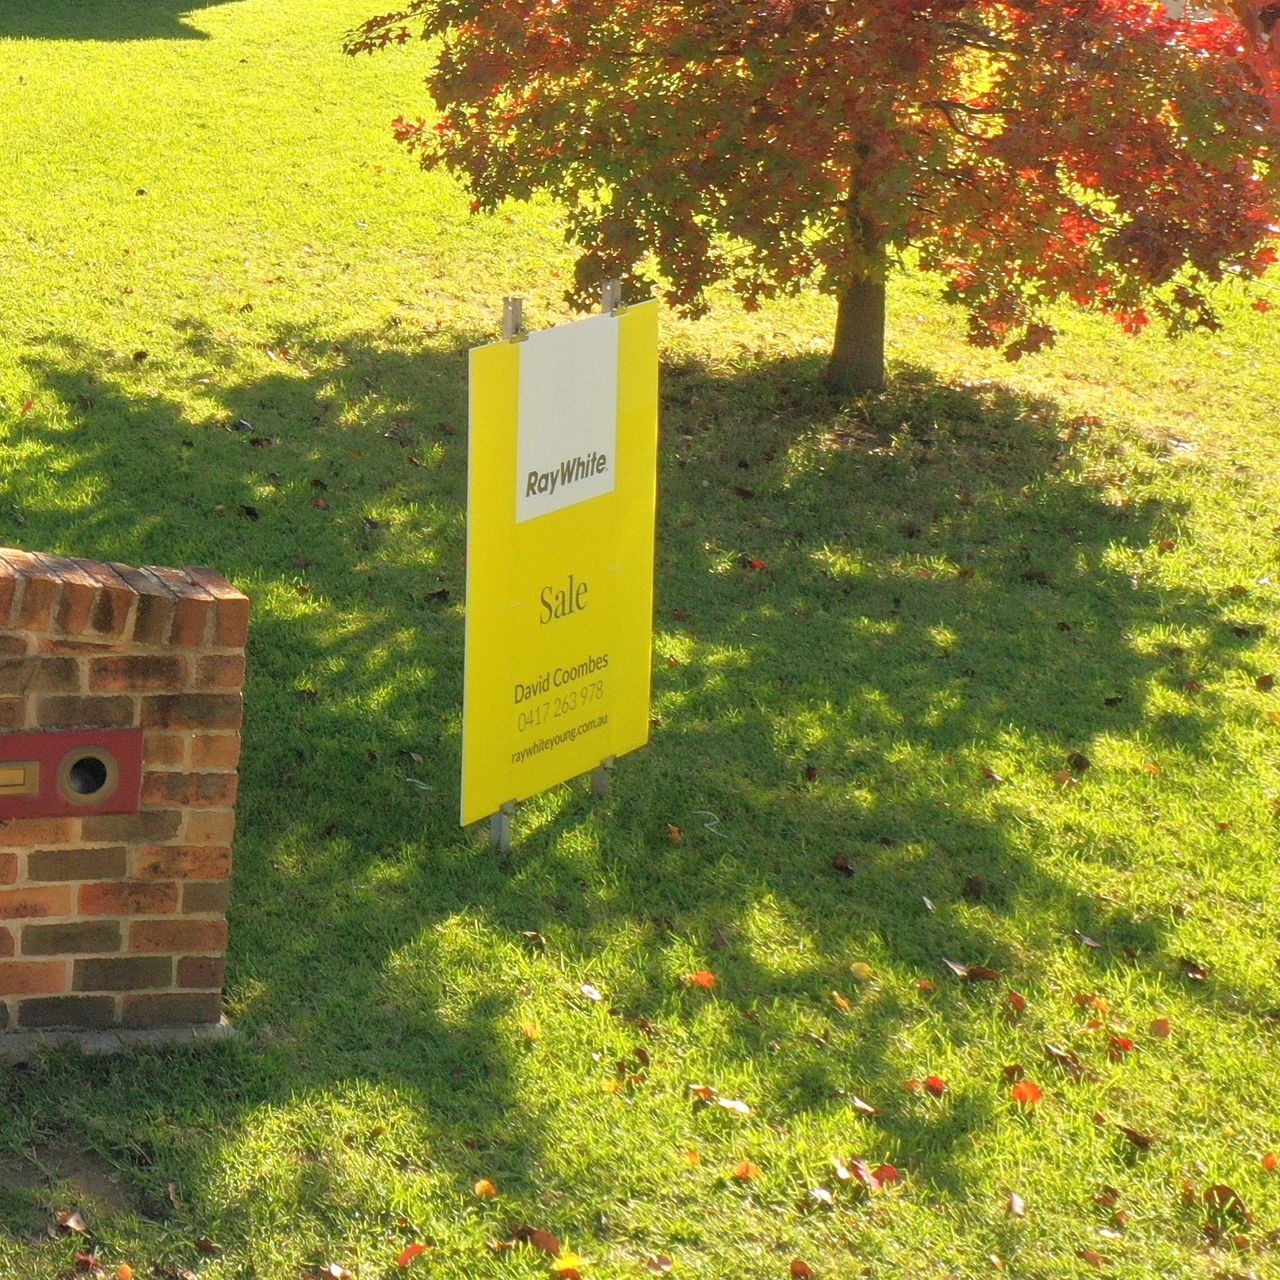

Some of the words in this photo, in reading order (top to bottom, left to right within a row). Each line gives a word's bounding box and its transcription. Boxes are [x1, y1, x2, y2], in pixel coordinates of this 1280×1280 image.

[540, 574, 588, 625] Sale
[514, 672, 550, 705] David
[553, 654, 609, 687] Coombes
[517, 702, 550, 733] 0417
[554, 691, 577, 718] 263
[580, 680, 603, 706] 978
[511, 713, 608, 764] raywhiteyoung.com.au
